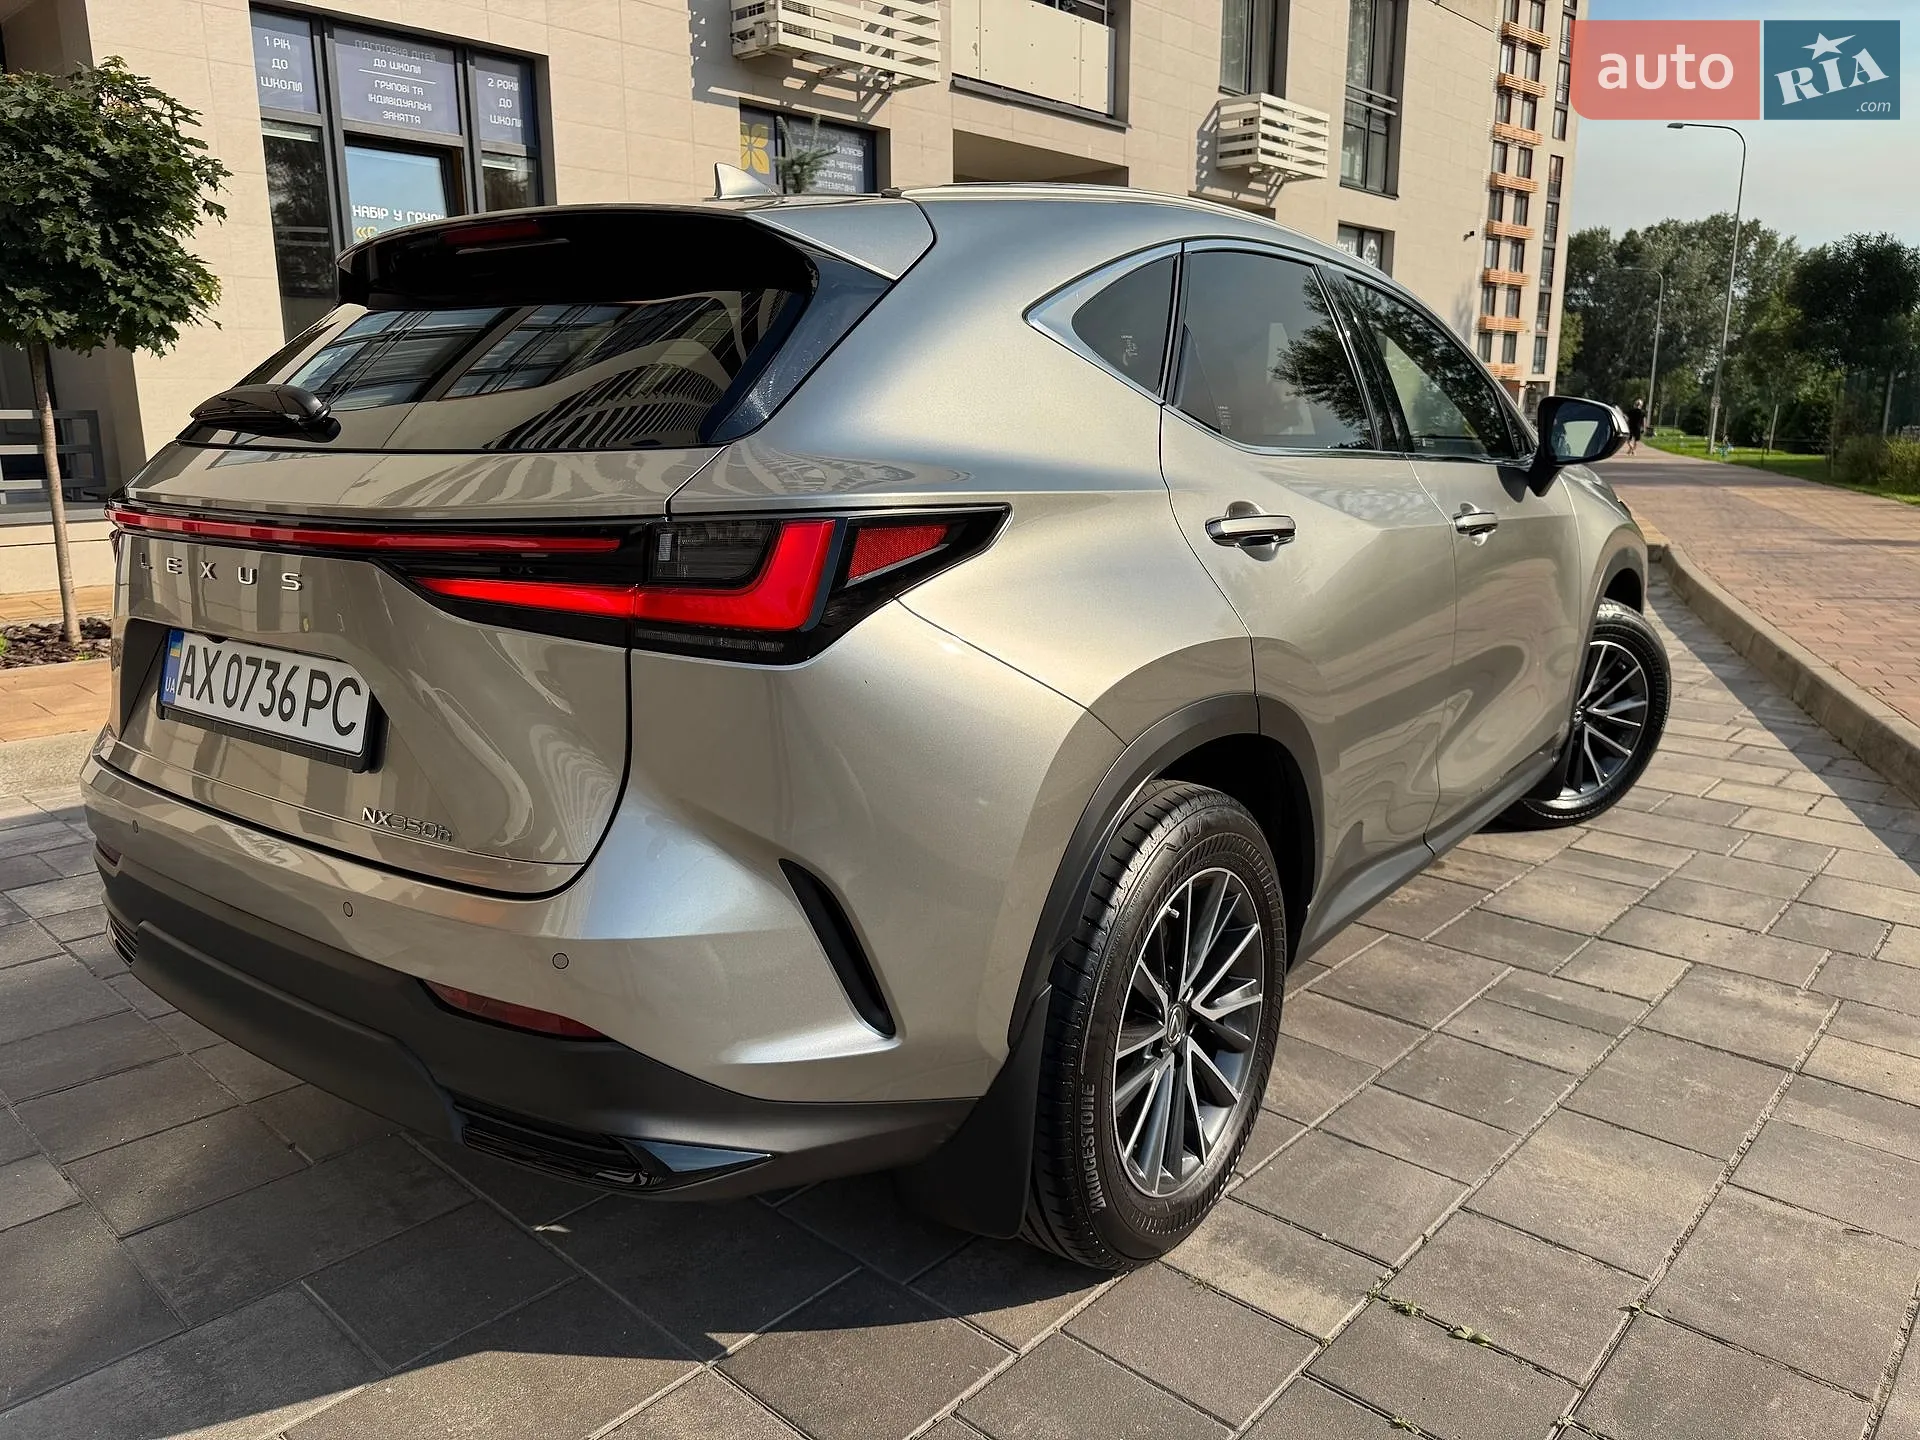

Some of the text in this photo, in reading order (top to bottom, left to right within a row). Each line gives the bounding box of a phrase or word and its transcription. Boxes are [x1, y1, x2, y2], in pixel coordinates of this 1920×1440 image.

[264, 36, 291, 50] 1 РІК
[271, 58, 289, 70] ДО
[373, 58, 422, 74] ДО ШКОЛИ
[260, 76, 303, 92] ШКОЛИ
[374, 79, 424, 95] ГРУПОВІ ТА
[487, 77, 494, 87] 2
[499, 97, 512, 108] ДО
[382, 110, 421, 124] ЗАНЯТТЯ
[352, 204, 389, 219] НАБІР
[393, 209, 402, 221] У
[140, 552, 303, 591] LEXUS
[165, 676, 175, 693] UA
[1080, 1083, 1107, 1213] BRIDGESTONE
